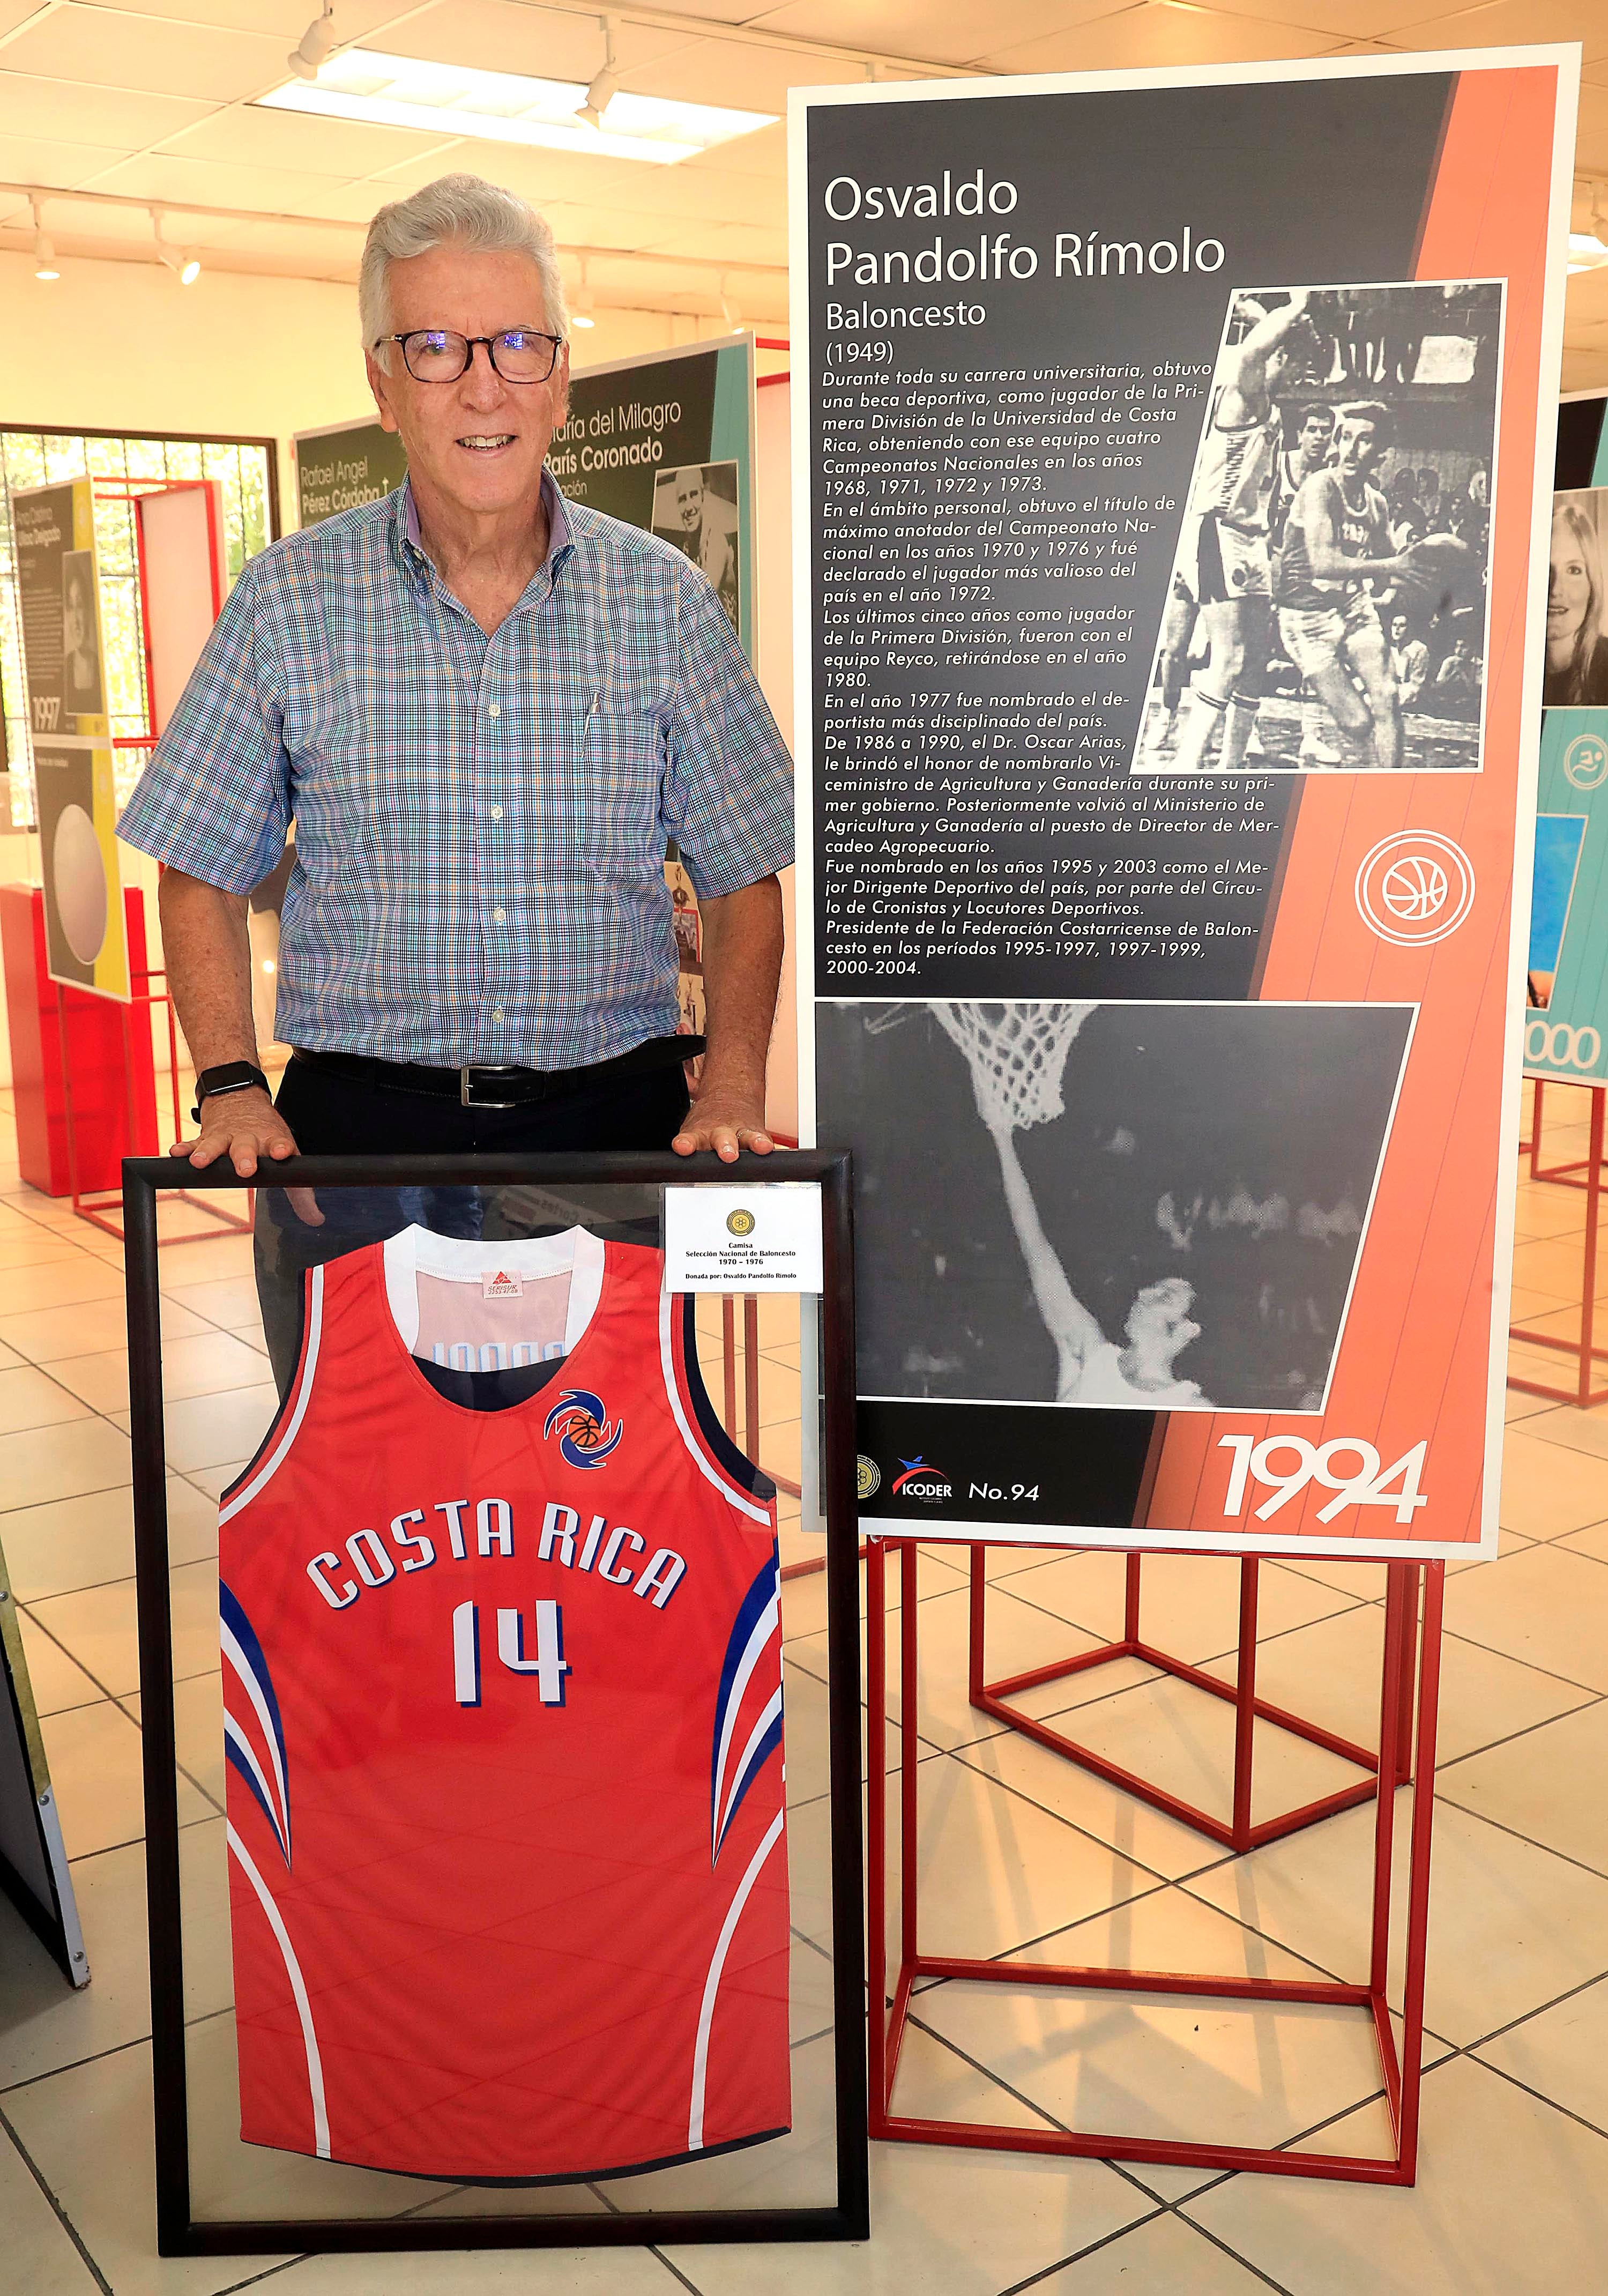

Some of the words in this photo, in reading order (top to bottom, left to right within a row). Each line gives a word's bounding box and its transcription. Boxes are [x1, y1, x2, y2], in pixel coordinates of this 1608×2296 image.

[823, 168, 1018, 221] Osvaldo
[826, 233, 1039, 286] Pandolfo
[1054, 226, 1226, 278] Rímolo
[826, 300, 986, 331] Baloncesto
[825, 340, 894, 366] (1949)
[822, 371, 890, 387] Durante
[896, 368, 933, 384] toda
[940, 372, 958, 383] su
[964, 370, 1026, 382] carrera
[1033, 363, 1145, 380] universitaria,
[1152, 360, 1212, 377] obtuvo
[822, 397, 853, 408] una
[860, 392, 899, 407] beca
[906, 390, 991, 410] deportiva,
[998, 392, 1044, 404] como
[1050, 385, 1119, 406] jugador
[1124, 384, 1145, 400] de
[1152, 383, 1167, 399] la
[1174, 383, 1204, 398] Pri-
[553, 414, 585, 443] aría
[590, 407, 614, 436] del
[619, 402, 681, 433] Milagro
[581, 436, 663, 472] Coronado
[823, 437, 861, 454] Rica,
[869, 433, 964, 451] obteniendo
[970, 437, 1000, 449] con
[1007, 436, 1034, 448] ese
[1041, 432, 1100, 450] equipo
[1106, 430, 1161, 445] cuatro
[300, 462, 335, 487] Rafael
[336, 455, 368, 485] Angel
[823, 458, 937, 477] Campeonatos
[943, 454, 1039, 471] Nacionales
[1045, 458, 1065, 469] en
[1072, 452, 1096, 468] los
[1102, 452, 1143, 467] años
[302, 492, 331, 515] Pérez
[332, 483, 380, 510] Córdoba
[823, 503, 843, 517] En
[849, 501, 864, 517] el
[870, 500, 928, 516] ámbito
[934, 498, 1011, 519] personal,
[1018, 497, 1076, 513] obtuvo
[1083, 496, 1098, 511] el
[1104, 495, 1148, 511] título
[1155, 494, 1175, 510] de
[823, 544, 873, 560] cional
[879, 548, 899, 559] en
[906, 543, 929, 559] los
[935, 544, 974, 558] años
[983, 542, 1024, 558] 1970
[1029, 546, 1040, 560] y
[1048, 540, 1089, 556] 1976
[1095, 545, 1105, 559] y
[1111, 539, 1137, 555] fué
[823, 588, 857, 606] país
[862, 592, 882, 602] en
[889, 586, 904, 602] el
[910, 587, 941, 601] año
[950, 586, 995, 601] 1972.
[824, 610, 850, 624] Los
[856, 608, 915, 623] últimos
[921, 608, 965, 623] cinco
[971, 608, 1010, 622] años
[1016, 611, 1062, 621] como
[1068, 605, 1135, 625] jugador
[824, 652, 880, 670] equipo
[886, 651, 938, 669] Reyco,
[946, 649, 1040, 665] retirándose
[1046, 653, 1067, 664] en
[1073, 648, 1089, 664] el
[1095, 649, 1126, 663] año
[32, 696, 61, 732] 1997
[824, 715, 885, 732] portista
[891, 714, 925, 729] más
[930, 712, 1030, 732] disciplinado
[1037, 712, 1062, 727] del
[1068, 713, 1107, 731] país.
[825, 736, 846, 750] De
[855, 735, 895, 750] 1986
[901, 739, 911, 749] a
[920, 735, 964, 751] 1990,
[972, 734, 987, 749] el
[993, 734, 1017, 748] Dr.
[1024, 734, 1075, 748] Oscar
[1078, 734, 1126, 751] Arias,
[825, 777, 908, 791] ceministro
[914, 776, 934, 791] de
[939, 776, 1031, 794] Agricultura
[1037, 781, 1047, 794] y
[1053, 775, 1142, 791] Ganadería
[1149, 777, 1214, 790] durante
[1220, 780, 1239, 790] su
[1245, 776, 1275, 793] pri-
[824, 818, 914, 836] Agricultura
[920, 822, 930, 836] y
[935, 818, 1023, 832] Ganadería
[1030, 818, 1045, 832] al
[1051, 819, 1105, 836] puesto
[1112, 817, 1132, 832] de
[1138, 818, 1207, 832] Director
[1212, 817, 1233, 832] de
[1239, 818, 1279, 832] Mer-
[825, 880, 848, 897] jor
[853, 880, 928, 897] Dirigente
[934, 880, 1013, 897] Deportivo
[1019, 879, 1045, 894] del
[1050, 880, 1089, 897] país,
[1096, 885, 1125, 898] por
[1129, 882, 1174, 898] parte
[1180, 880, 1206, 894] del
[1212, 880, 1262, 895] Círcu-
[826, 919, 909, 934] Presidente
[915, 920, 935, 934] de
[941, 920, 956, 934] la
[962, 920, 1053, 935] Federación
[1060, 921, 1172, 935] Costarricense
[1178, 921, 1198, 935] de
[1204, 921, 1259, 936] Balon-
[826, 942, 867, 954] cesto
[873, 945, 892, 954] en
[898, 940, 921, 954] los
[926, 940, 996, 958] períodos
[1005, 941, 1099, 957] 1995-1997,
[1110, 942, 1205, 958] 1997-1999,
[827, 960, 921, 974] 2000-2004.
[1524, 1020, 1602, 1069] 000
[903, 1483, 952, 1497] ICODER
[969, 1482, 1040, 1501] No.94
[1216, 1434, 1428, 1525] 1994
[306, 1498, 515, 1609] COSTA
[538, 1502, 688, 1610] RICA
[452, 1599, 572, 1707] 14
